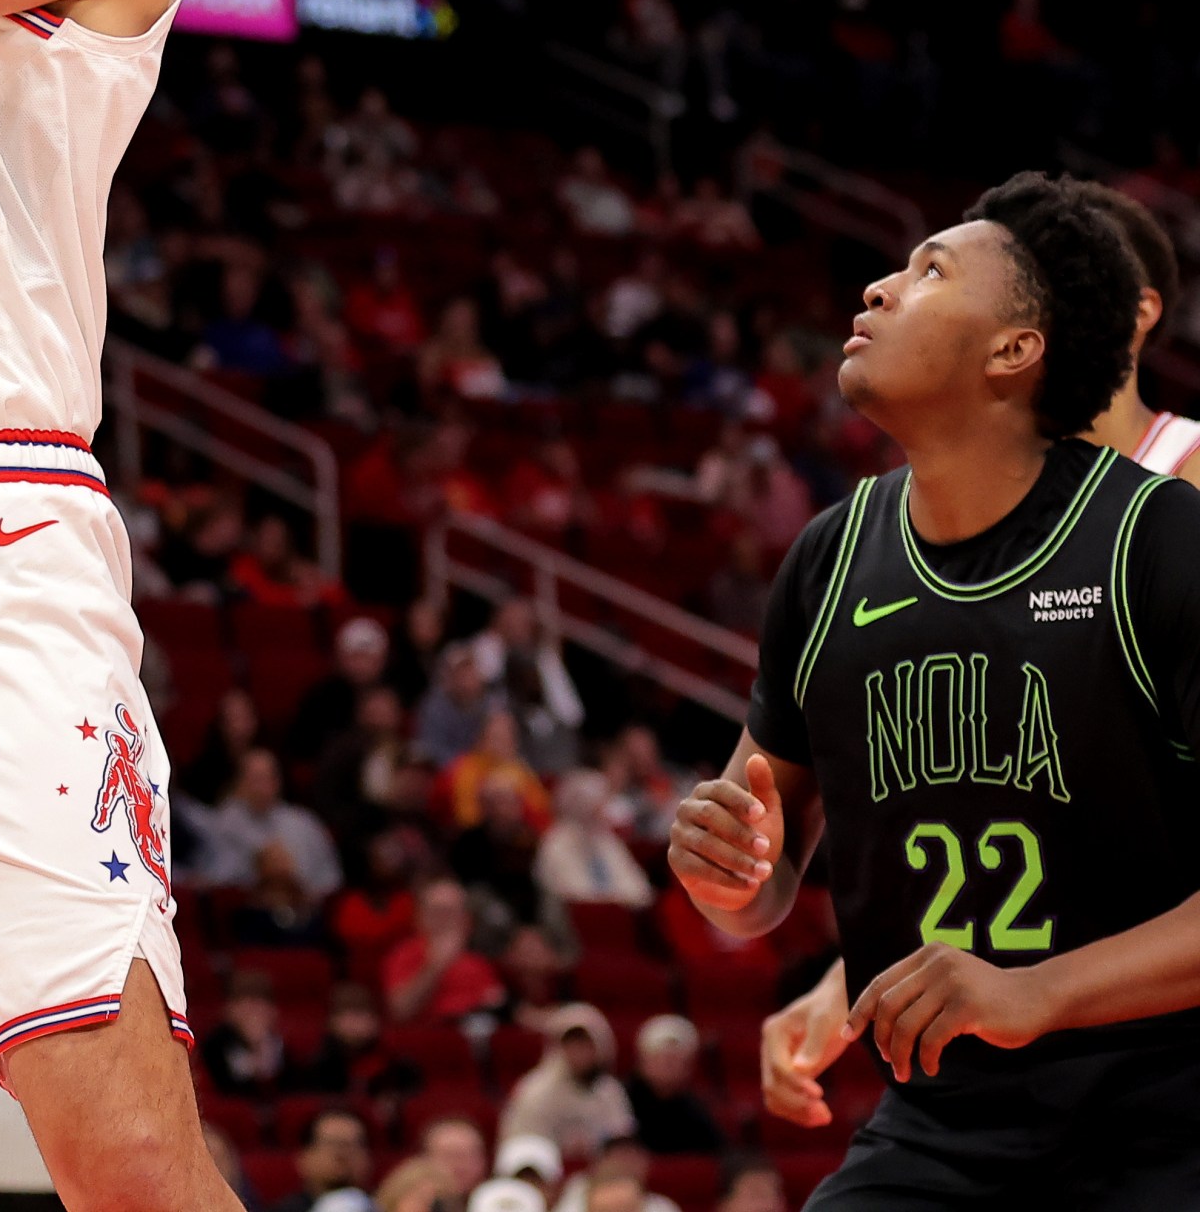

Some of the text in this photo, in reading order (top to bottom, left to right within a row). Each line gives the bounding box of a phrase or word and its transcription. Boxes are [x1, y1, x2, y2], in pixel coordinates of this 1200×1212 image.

[1028, 586, 1103, 609] NEWAGE
[1033, 607, 1094, 622] PRODUCTS
[865, 652, 1071, 804] NOLA
[905, 821, 1054, 951] 22
